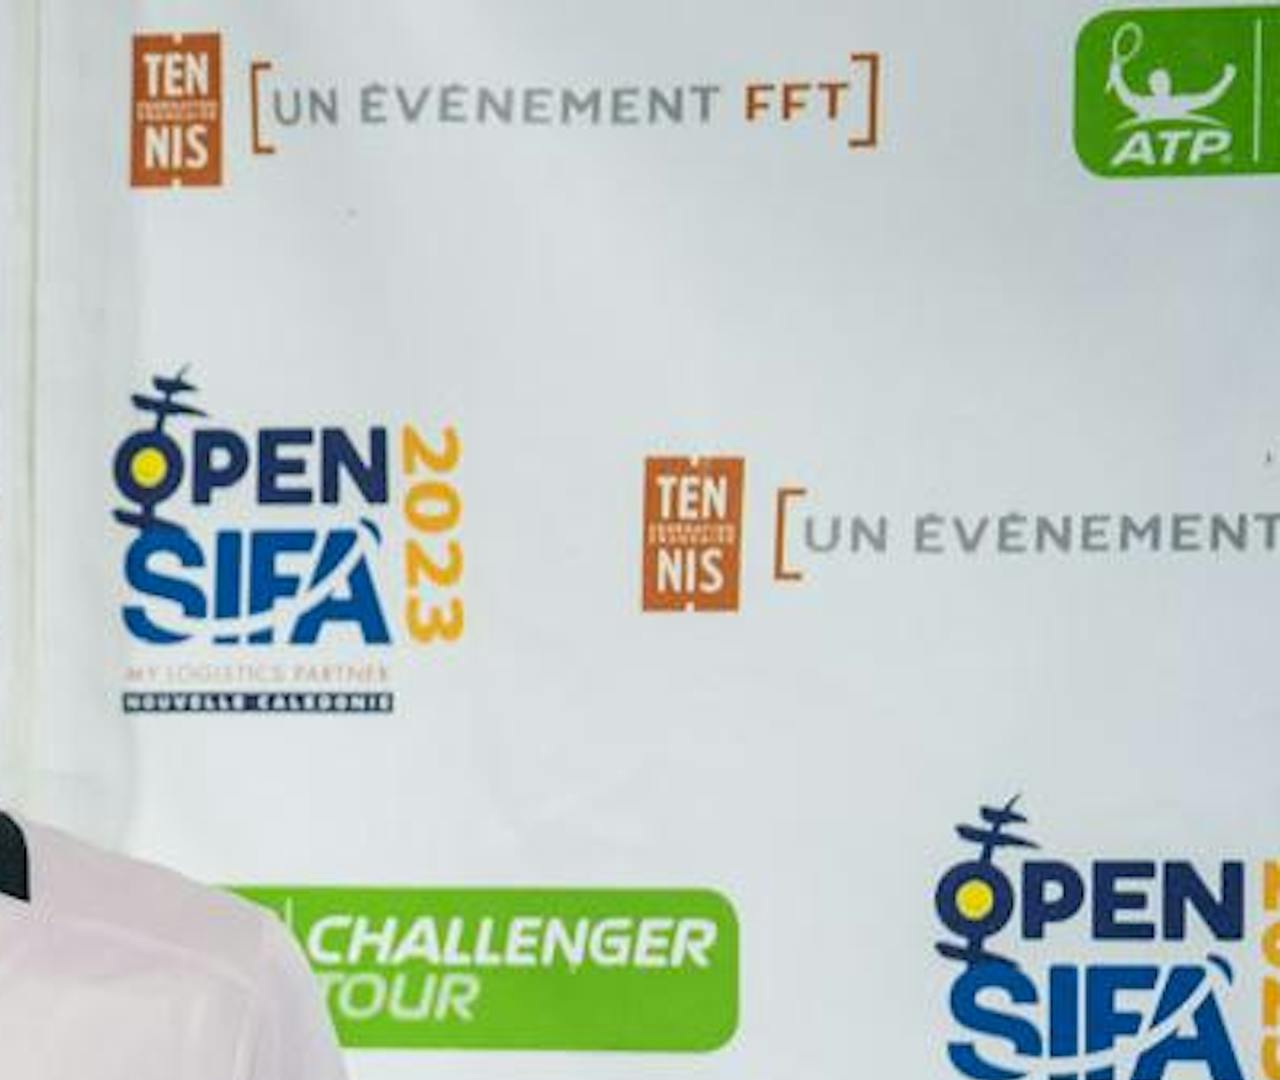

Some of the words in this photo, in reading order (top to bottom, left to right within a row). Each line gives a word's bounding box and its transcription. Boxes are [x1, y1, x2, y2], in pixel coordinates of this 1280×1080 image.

[142, 53, 209, 97] TEN
[272, 87, 339, 126] UN
[359, 82, 722, 126] ÉVÉNEMENT
[745, 83, 850, 121] FFT
[144, 125, 209, 170] NIS
[1109, 129, 1233, 167] ATP
[113, 424, 390, 505] OPEN
[656, 475, 728, 519] TEN
[403, 423, 465, 645] 2023
[804, 515, 887, 553] UN
[915, 512, 1280, 555] ÉVÉNEMENT
[657, 548, 725, 594] NIS
[935, 859, 1246, 941] OPEN
[307, 914, 717, 968] CHALLENGER
[315, 972, 481, 1021] TOUR
